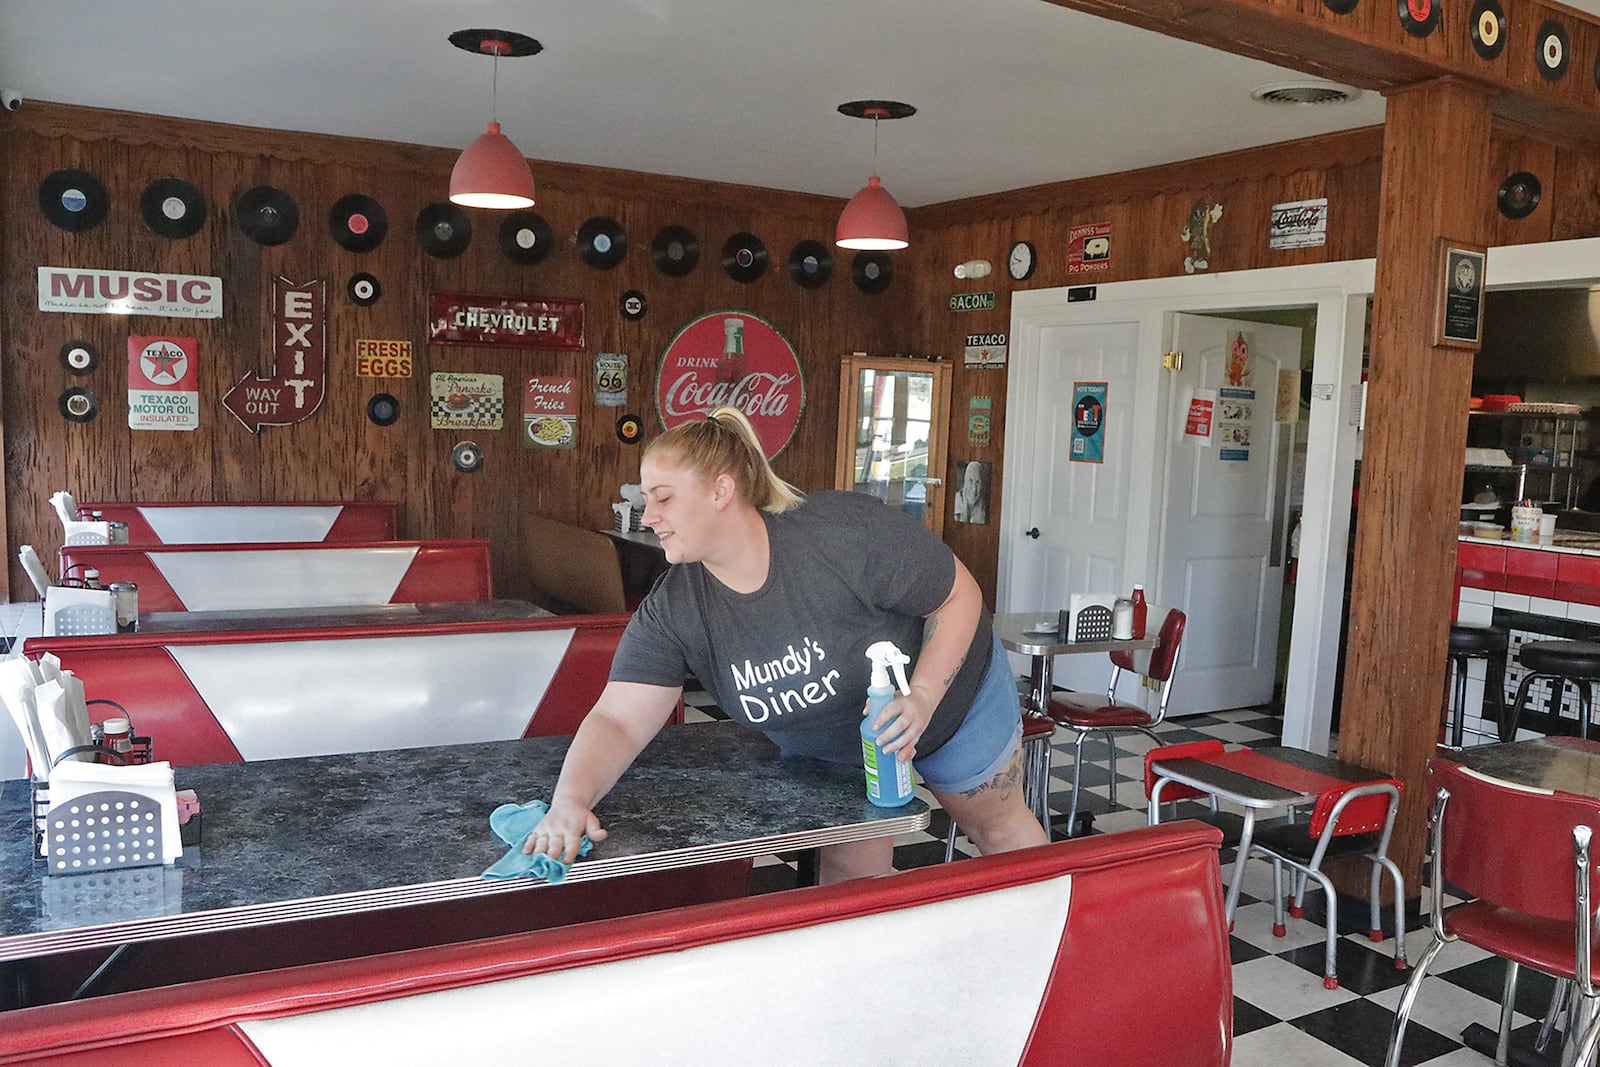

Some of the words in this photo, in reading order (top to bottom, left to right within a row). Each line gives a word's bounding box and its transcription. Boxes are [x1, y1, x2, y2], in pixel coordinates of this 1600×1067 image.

[50, 273, 211, 304] MUSIC
[950, 294, 987, 309] BACON
[455, 311, 559, 333] CHEVROLET
[967, 334, 1006, 345] TEXACO
[285, 291, 314, 408] EXIT
[358, 341, 411, 357] FRESH
[358, 358, 411, 376] EGGS
[677, 357, 718, 368] DRINK
[529, 378, 571, 394] French
[600, 372, 622, 388] 66
[245, 388, 281, 400] WAY
[447, 382, 496, 396] Pancake
[141, 395, 188, 405] TEXACO
[534, 395, 565, 410] Fries
[133, 404, 174, 414] MOTOR
[177, 405, 195, 415] OIL
[245, 402, 279, 414] OUT
[140, 414, 189, 422] INSULATED
[436, 416, 497, 428] Breakfast
[731, 637, 825, 691] Mundy's
[739, 669, 840, 723] Diner
